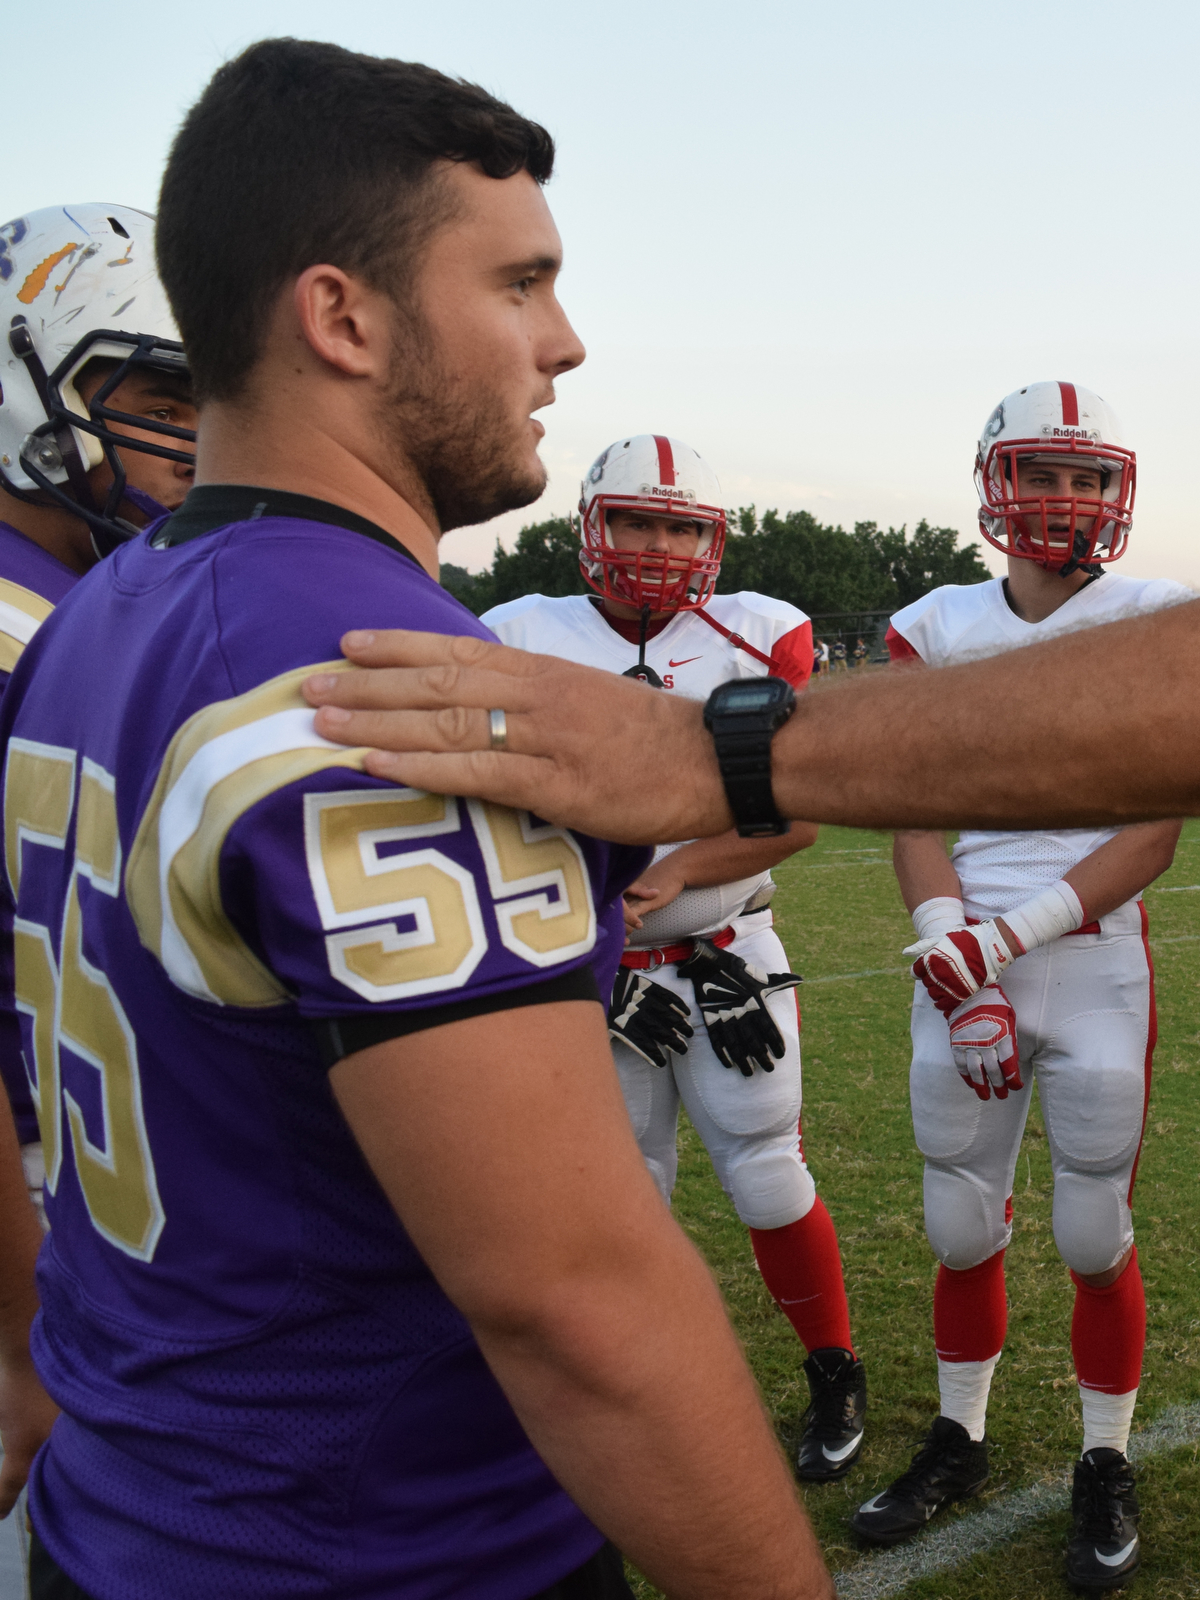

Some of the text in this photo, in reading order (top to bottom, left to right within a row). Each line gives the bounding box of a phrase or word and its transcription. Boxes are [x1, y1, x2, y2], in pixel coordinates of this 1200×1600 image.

[1053, 427, 1088, 439] Riddell
[652, 486, 684, 499] Riddell
[303, 787, 598, 1003] 55
